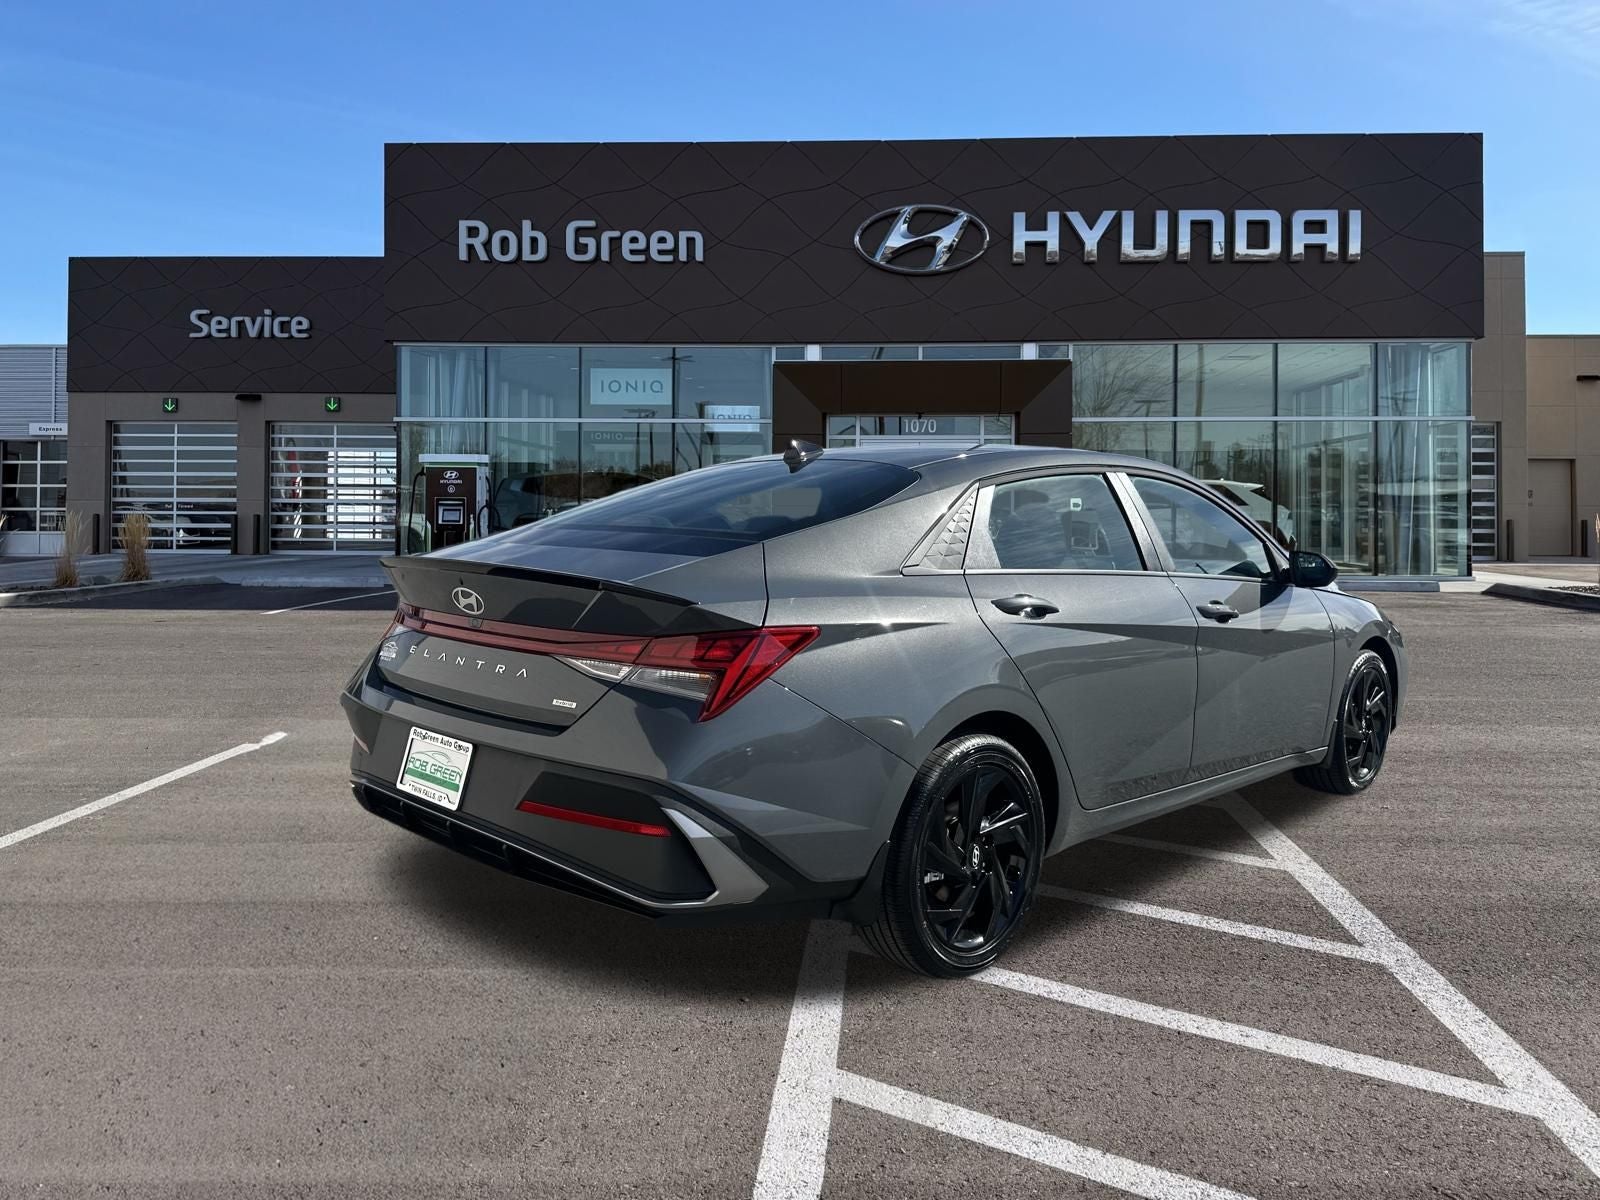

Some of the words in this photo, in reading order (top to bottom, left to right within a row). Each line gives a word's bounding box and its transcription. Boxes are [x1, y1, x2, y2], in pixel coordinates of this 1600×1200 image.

[458, 219, 548, 263] Rob
[565, 219, 705, 263] Green
[1012, 209, 1363, 264] HYUNDAI
[188, 308, 311, 339] Service
[600, 379, 664, 394] IONIQ
[903, 418, 937, 433] 1070
[409, 645, 528, 678] ELANTRA
[440, 737, 453, 748] Auto
[408, 756, 429, 772] ROB
[429, 763, 464, 784] GREEN
